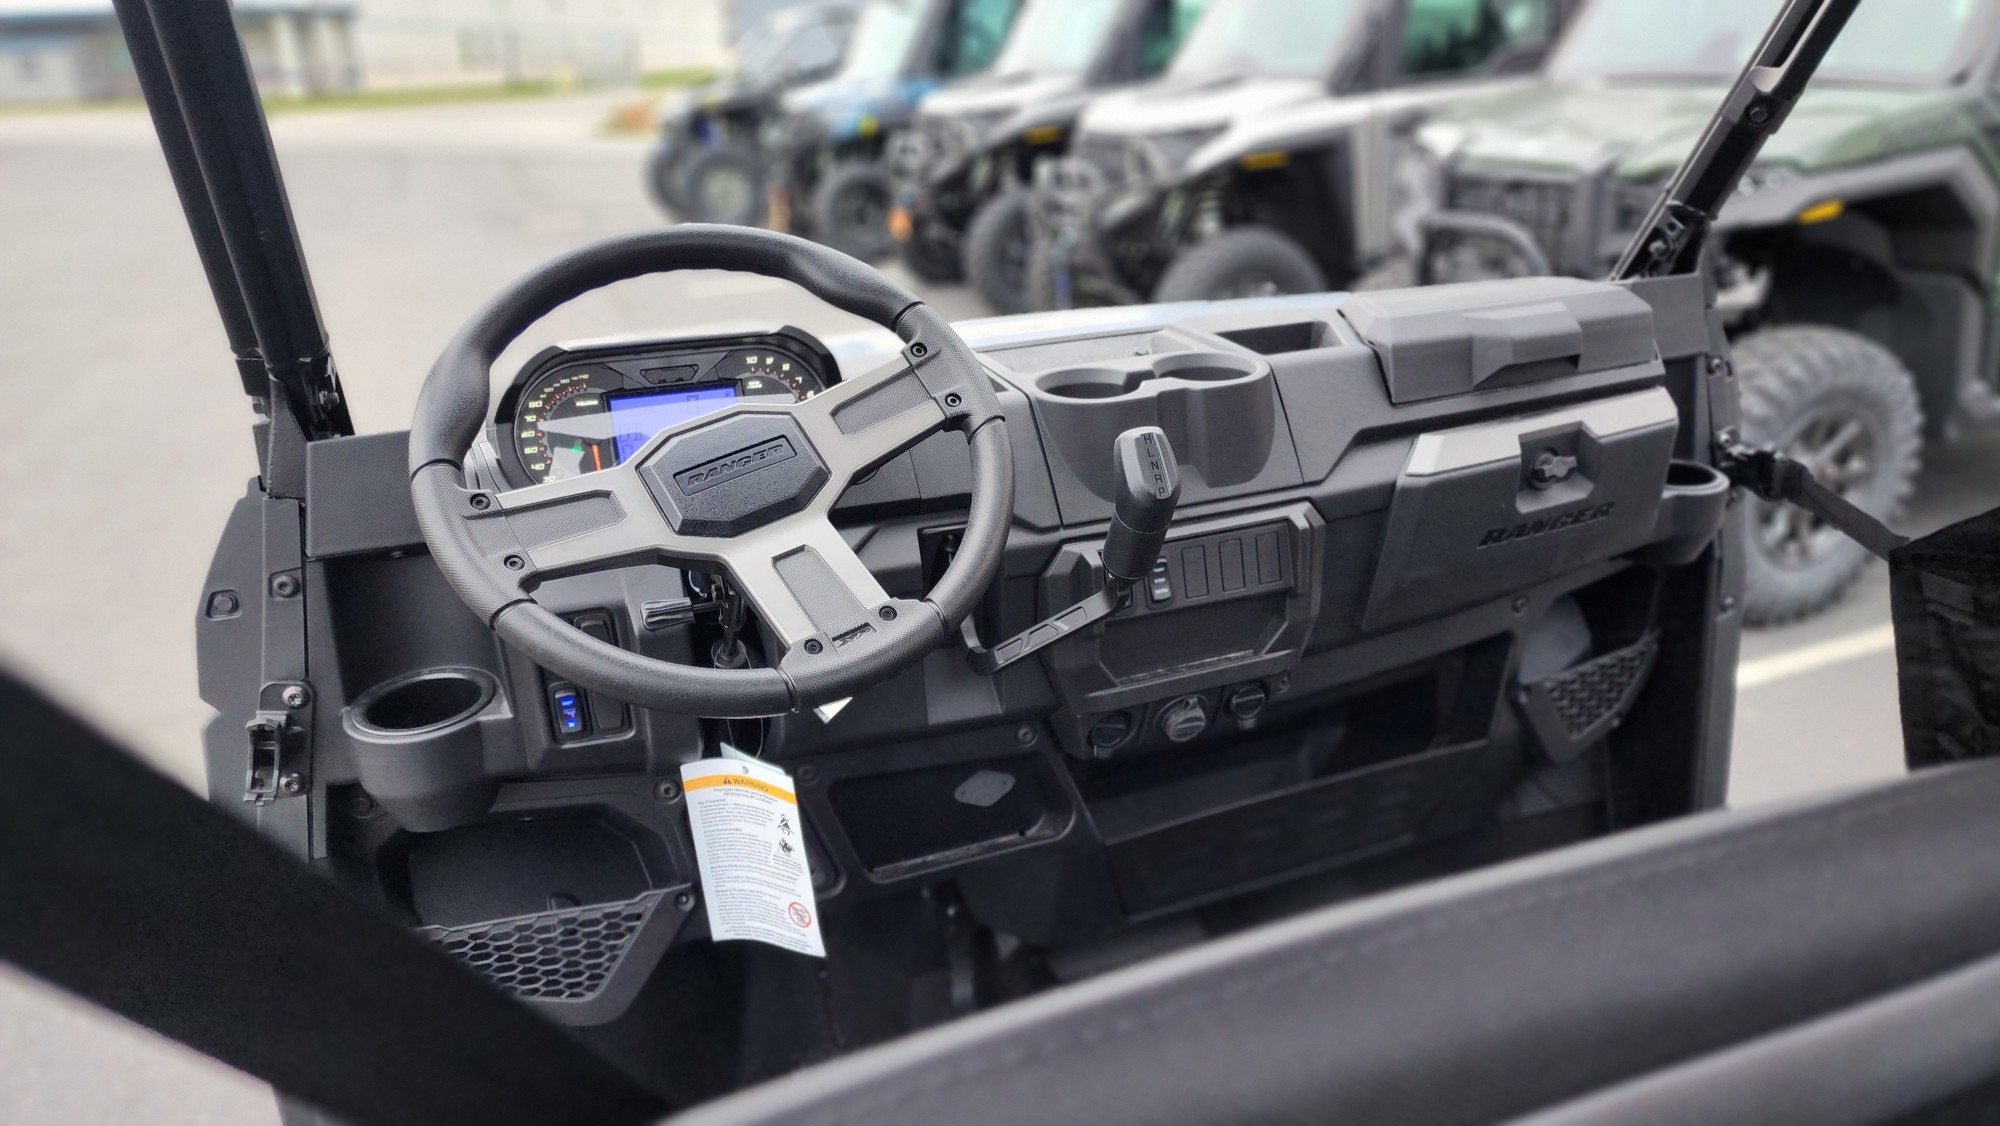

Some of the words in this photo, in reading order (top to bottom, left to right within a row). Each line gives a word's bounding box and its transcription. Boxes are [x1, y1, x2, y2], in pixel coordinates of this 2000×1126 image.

[746, 356, 758, 364] 10
[529, 400, 543, 408] 80
[1143, 434, 1153, 444] H
[524, 446, 538, 454] 50
[1146, 448, 1155, 458] L
[686, 444, 784, 488] RANGER
[1150, 460, 1160, 471] N
[542, 475, 556, 483] 30
[1154, 474, 1163, 484] R
[1158, 487, 1165, 498] P
[1476, 501, 1616, 550] RANGER
[733, 778, 769, 793] WARNING
